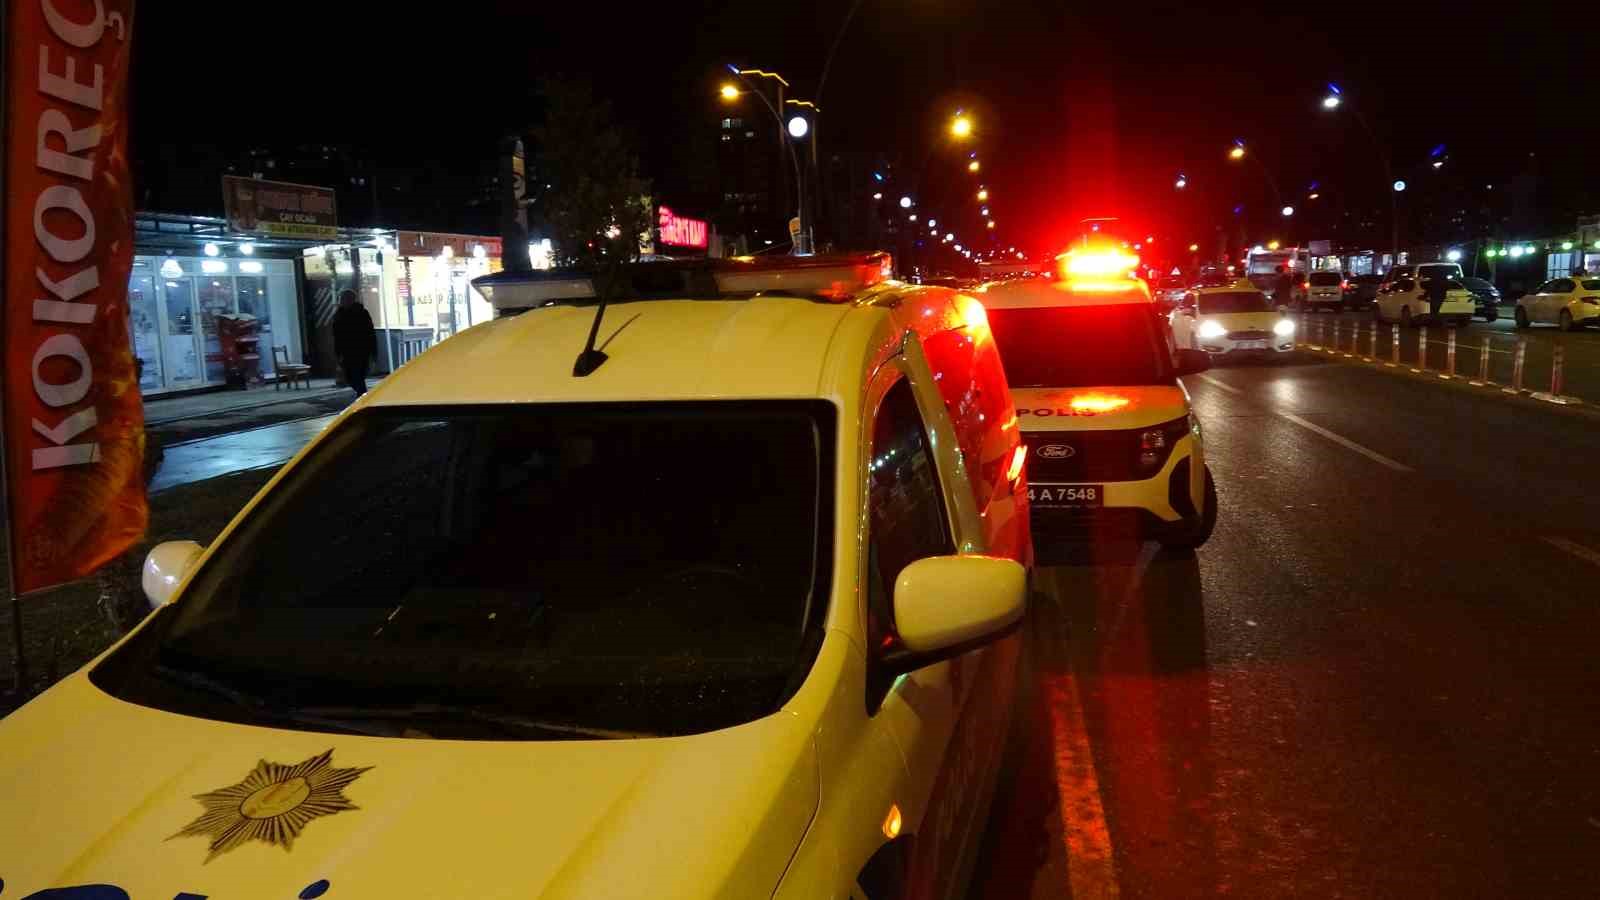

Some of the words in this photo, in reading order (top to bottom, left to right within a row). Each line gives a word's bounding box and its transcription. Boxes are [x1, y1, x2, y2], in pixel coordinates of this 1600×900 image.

[32, 0, 126, 471] KOKOREÇ
[1043, 446, 1068, 457] Ford
[1040, 489, 1053, 501] A
[1057, 488, 1096, 501] 7548
